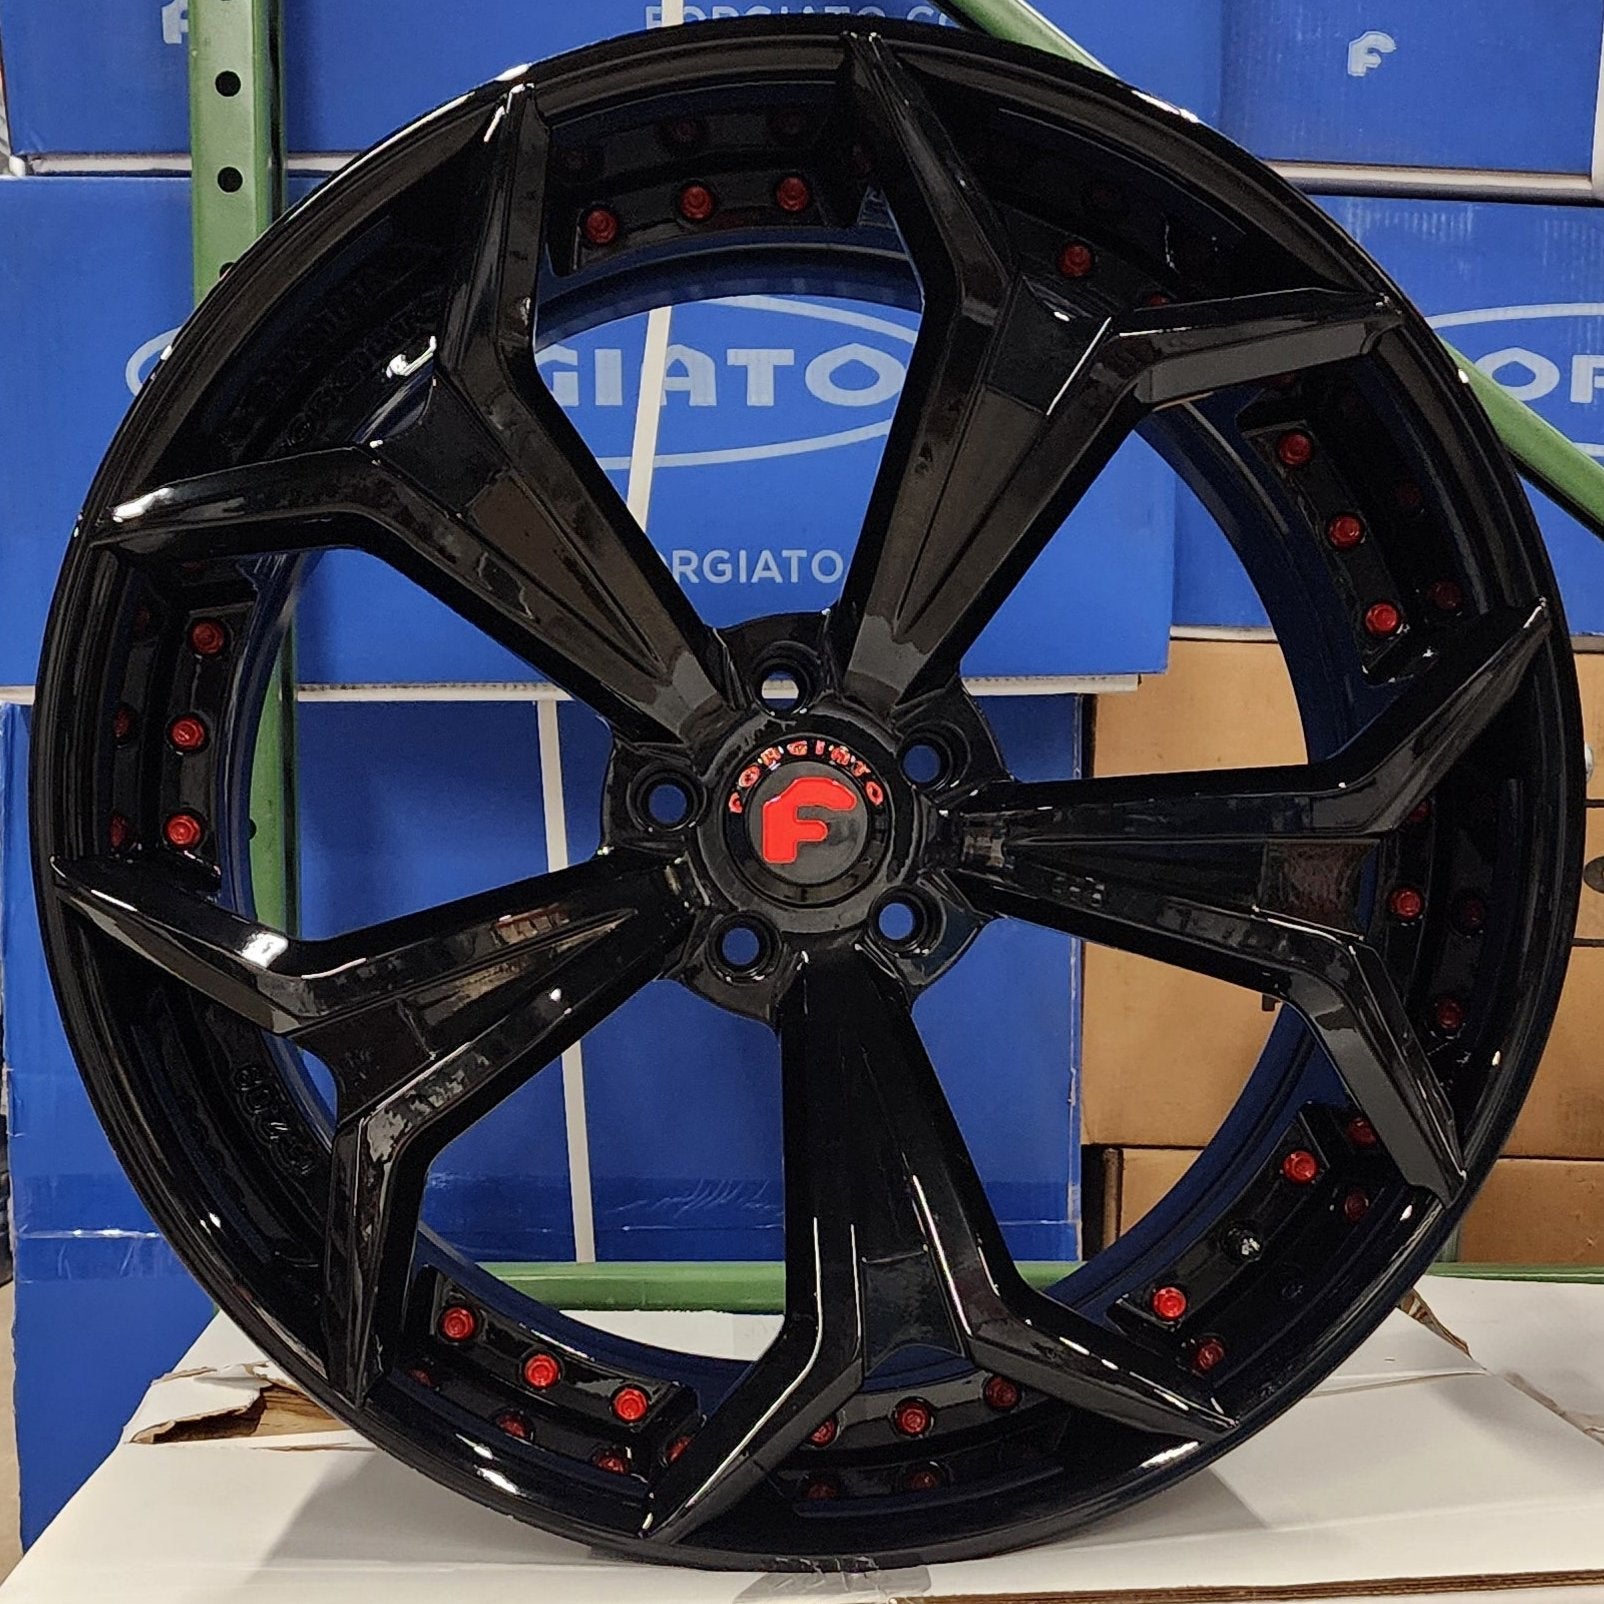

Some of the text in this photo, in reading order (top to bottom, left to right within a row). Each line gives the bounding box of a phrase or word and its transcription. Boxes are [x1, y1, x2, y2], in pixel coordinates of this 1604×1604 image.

[1348, 31, 1396, 76] F
[656, 549, 844, 583] RGIATO
[763, 777, 857, 864] F
